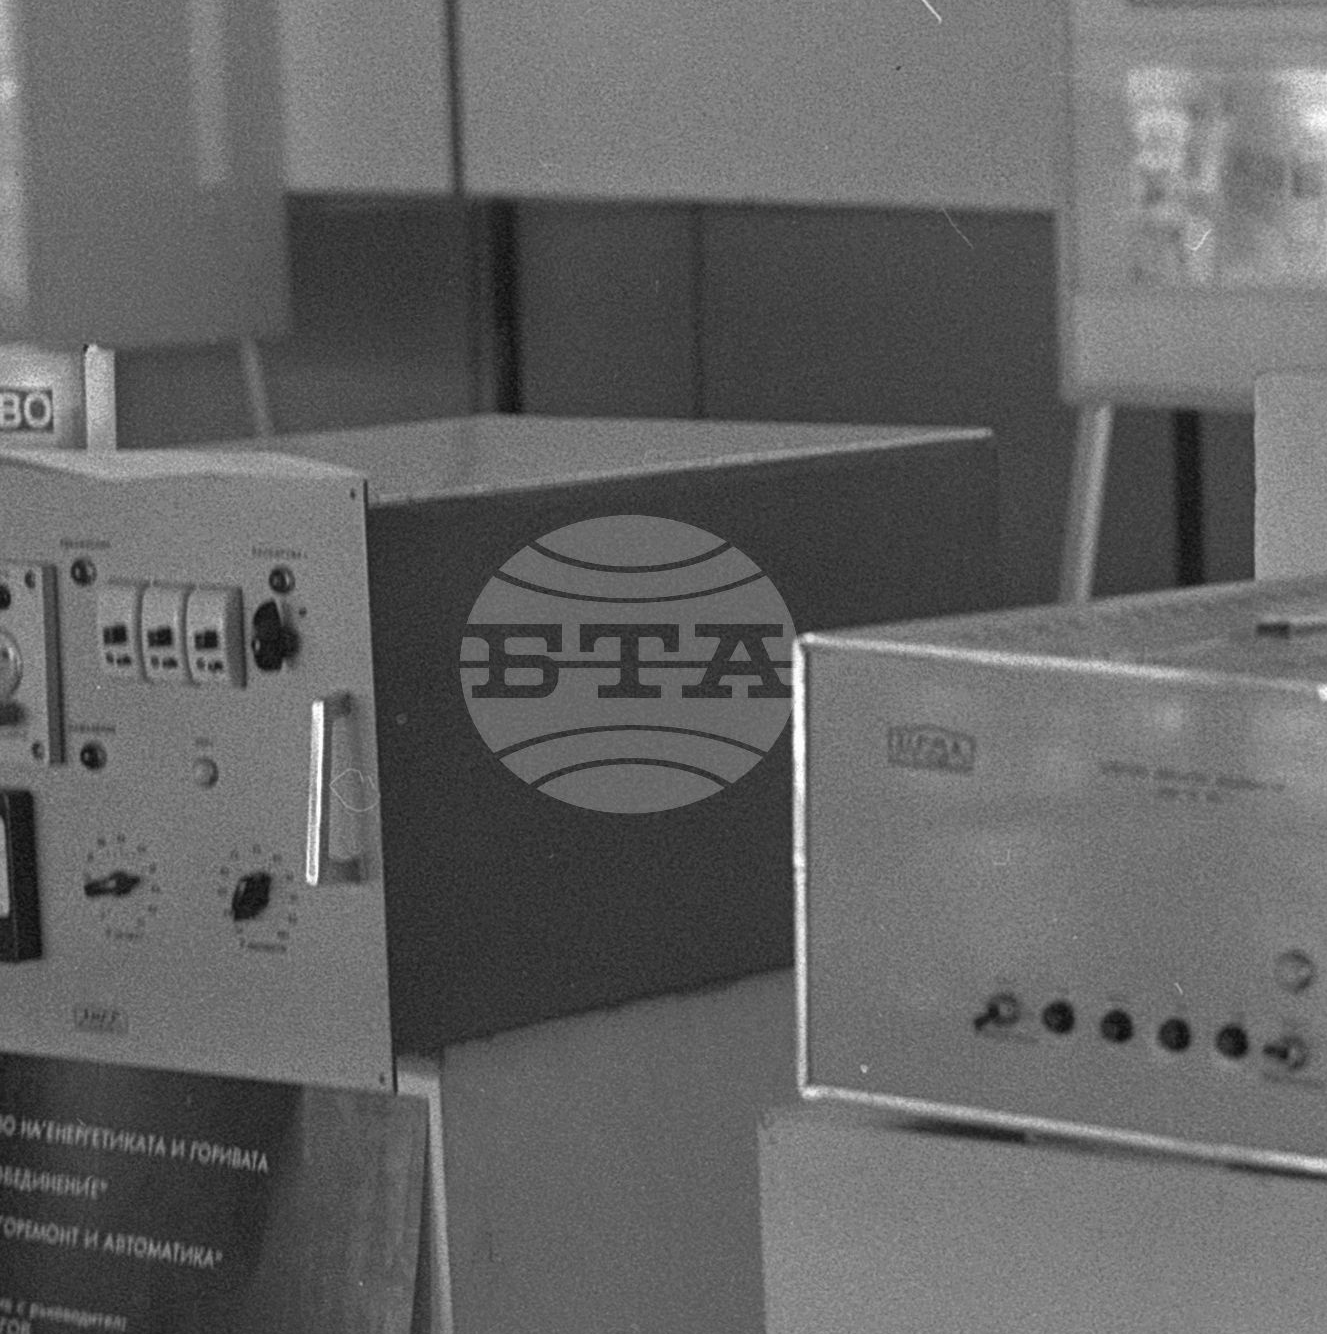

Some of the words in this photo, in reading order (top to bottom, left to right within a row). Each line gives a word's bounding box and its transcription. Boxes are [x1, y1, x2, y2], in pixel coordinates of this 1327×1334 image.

[46, 1120, 166, 1156] ЕНЕРГЕТИКАТА
[170, 1138, 187, 1159] И
[190, 1139, 270, 1173] ГОРИВАТА
[84, 1228, 99, 1250] И
